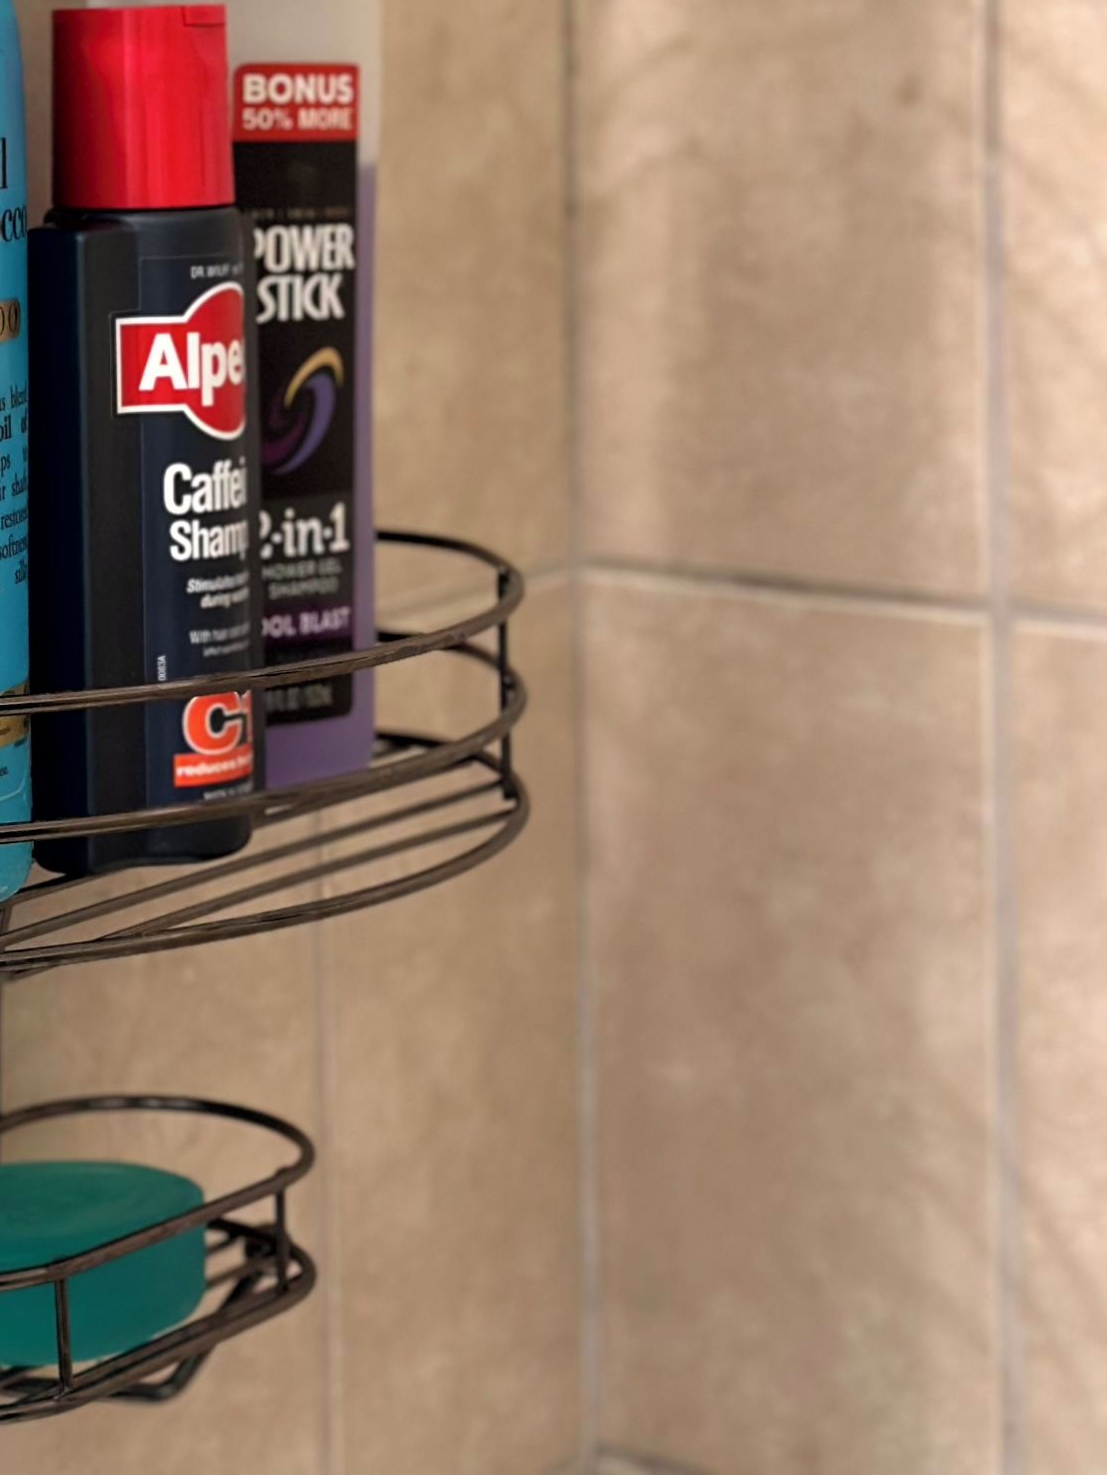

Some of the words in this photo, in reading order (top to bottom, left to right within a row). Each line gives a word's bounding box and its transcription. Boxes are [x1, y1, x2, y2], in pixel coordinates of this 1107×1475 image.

[242, 73, 354, 105] BONUS
[241, 107, 293, 131] 50%
[297, 106, 352, 131] MORE
[256, 273, 345, 324] STICK
